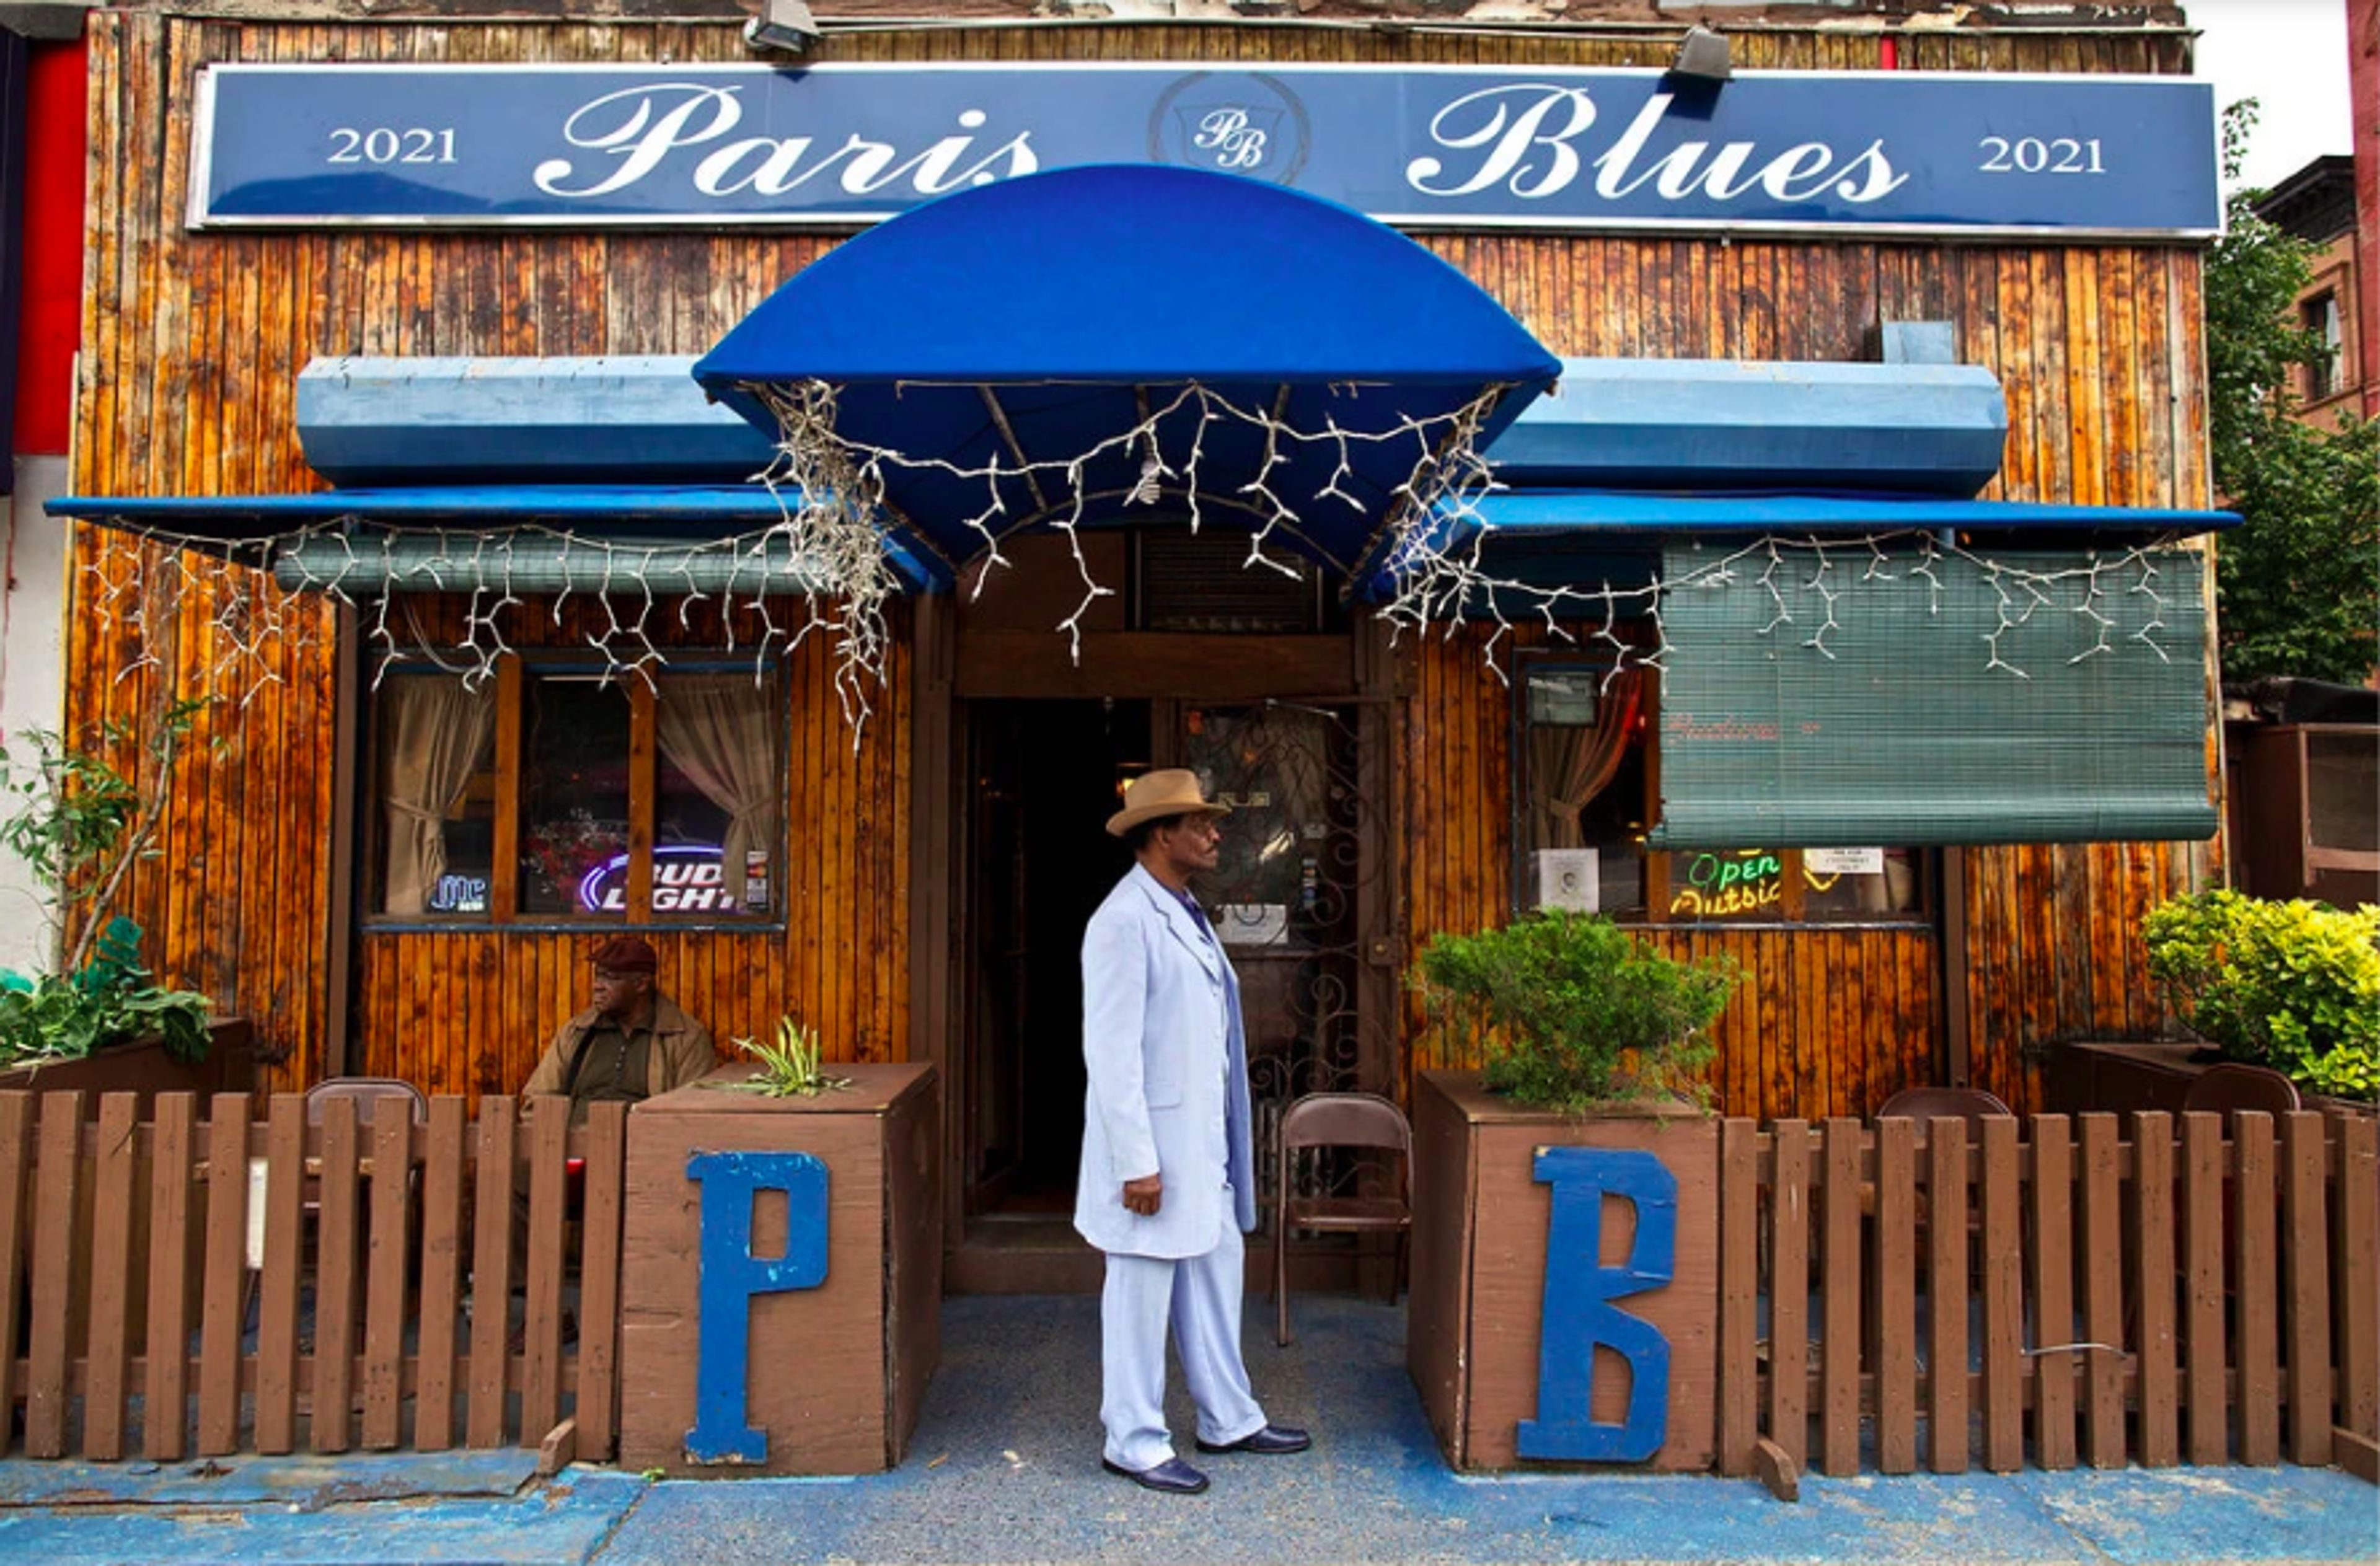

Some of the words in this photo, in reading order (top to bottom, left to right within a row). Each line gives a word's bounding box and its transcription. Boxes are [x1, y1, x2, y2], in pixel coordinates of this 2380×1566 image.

[327, 128, 456, 163] 2021
[533, 82, 1038, 196] Paris
[1406, 82, 1910, 201] Blues
[1980, 136, 2105, 173] 2021
[601, 887, 735, 910] LGHT
[1689, 853, 1781, 892] Open
[684, 1150, 829, 1464] P
[1517, 1145, 1677, 1461] B
